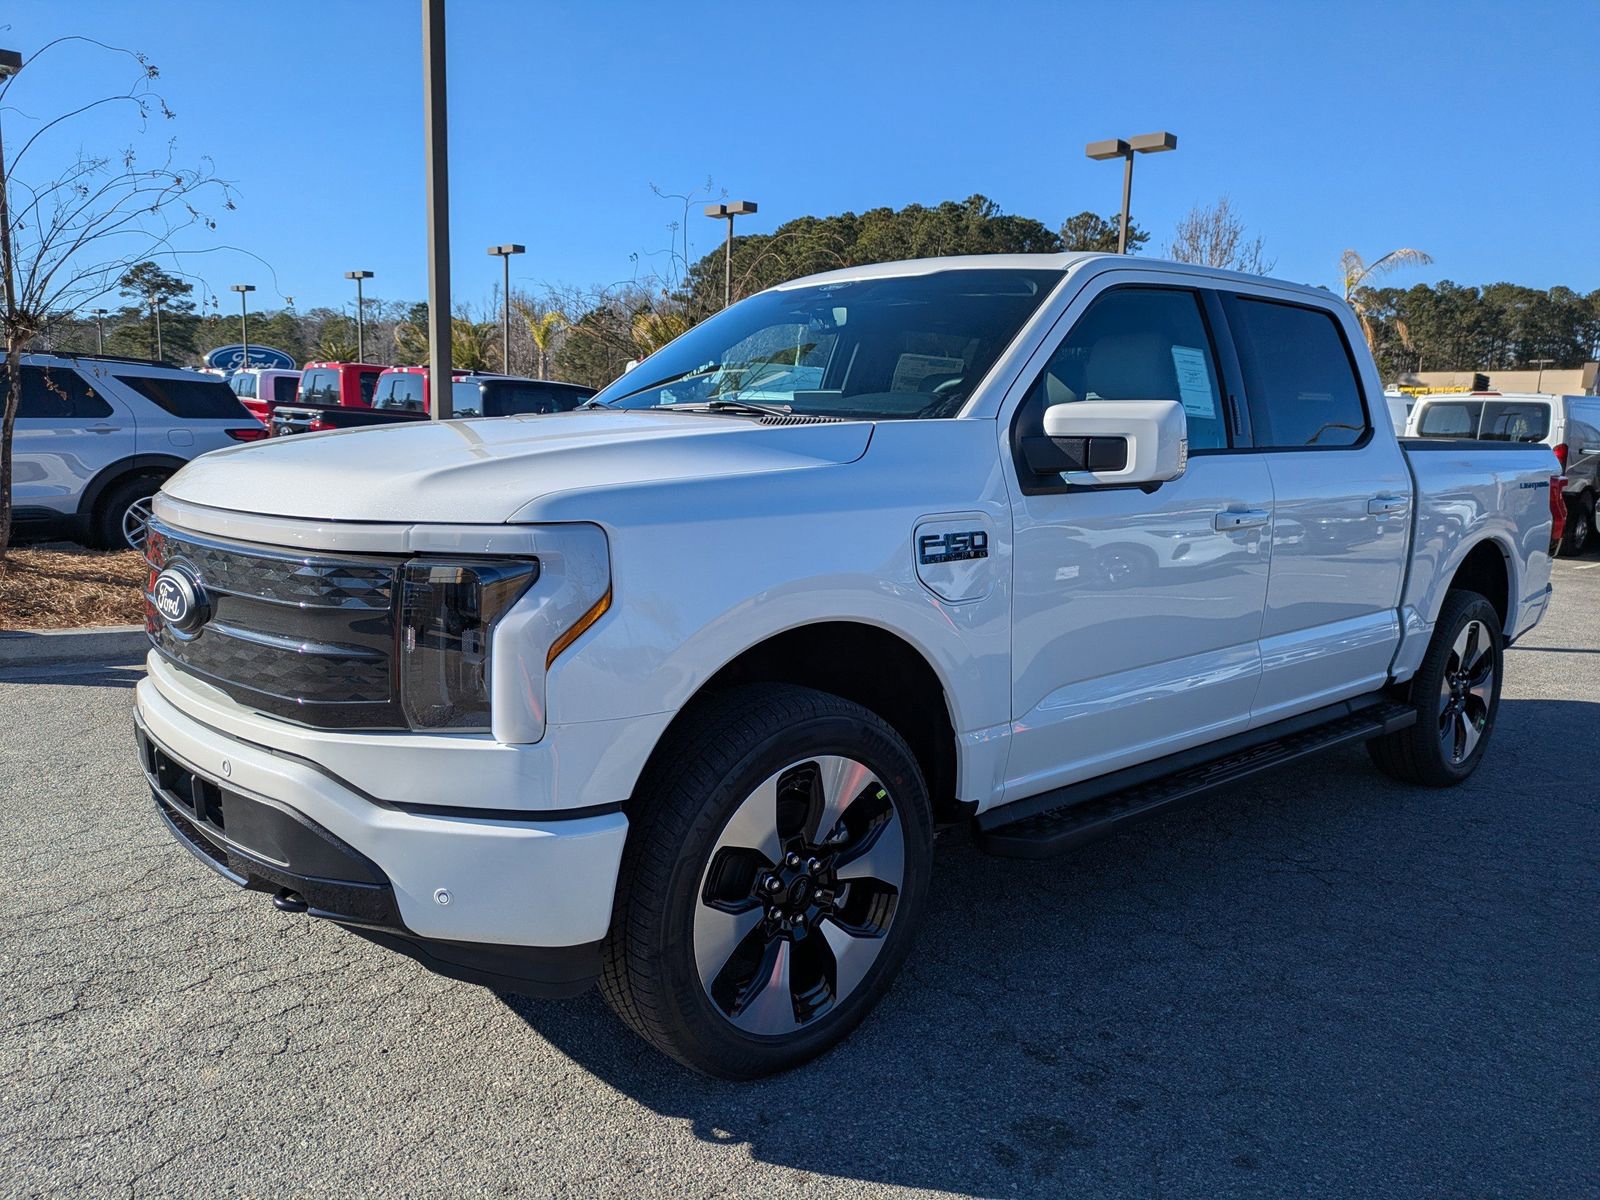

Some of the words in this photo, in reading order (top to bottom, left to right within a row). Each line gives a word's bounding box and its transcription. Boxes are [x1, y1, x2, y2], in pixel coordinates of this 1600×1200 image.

[227, 352, 278, 371] Ford
[919, 531, 988, 560] F-150
[158, 582, 180, 616] Ford
